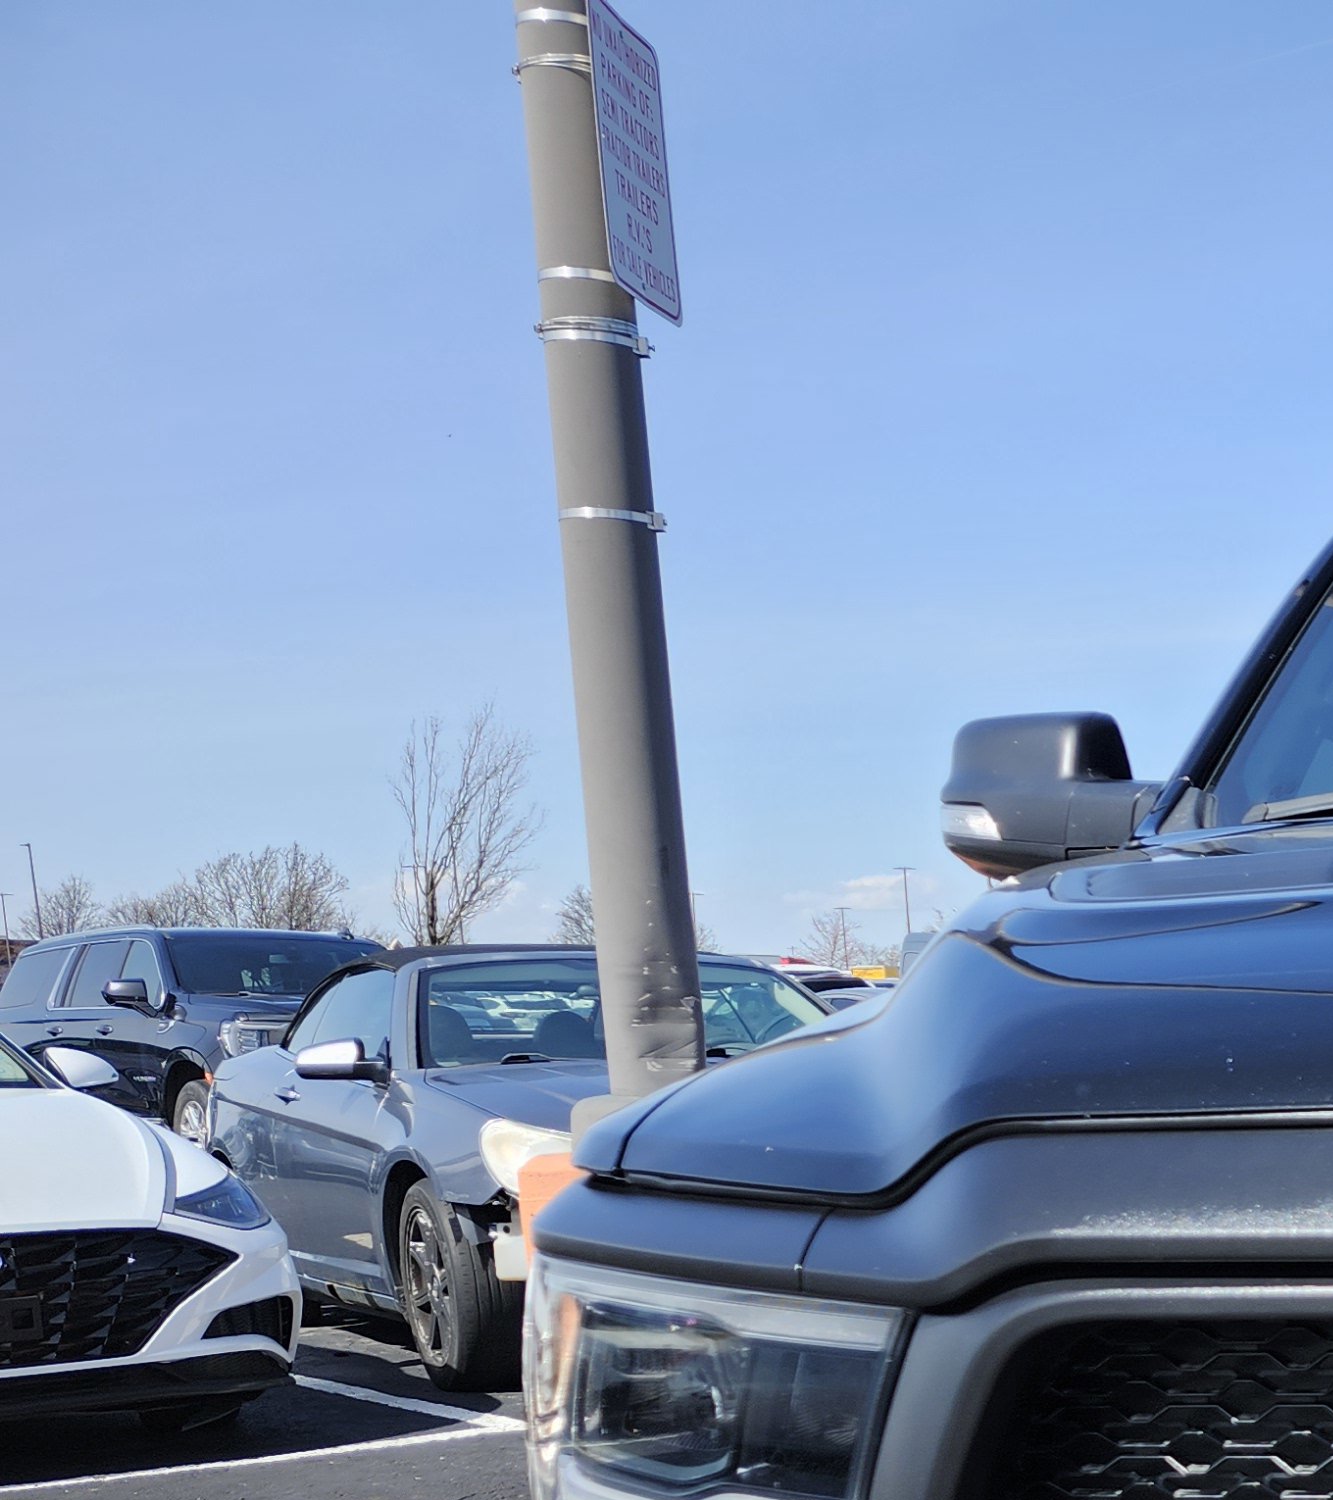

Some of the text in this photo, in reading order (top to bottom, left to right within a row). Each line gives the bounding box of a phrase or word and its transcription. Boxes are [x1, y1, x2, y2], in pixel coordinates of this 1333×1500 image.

[601, 52, 637, 108] PARKING
[603, 20, 657, 92] UNAUTHORIZED
[602, 87, 659, 161] SEMI TRACTORS
[602, 122, 666, 198] TRACTOR TRAILERS
[615, 168, 659, 226] TRAILERS
[613, 234, 676, 303] FOR SALE VEHICLES
